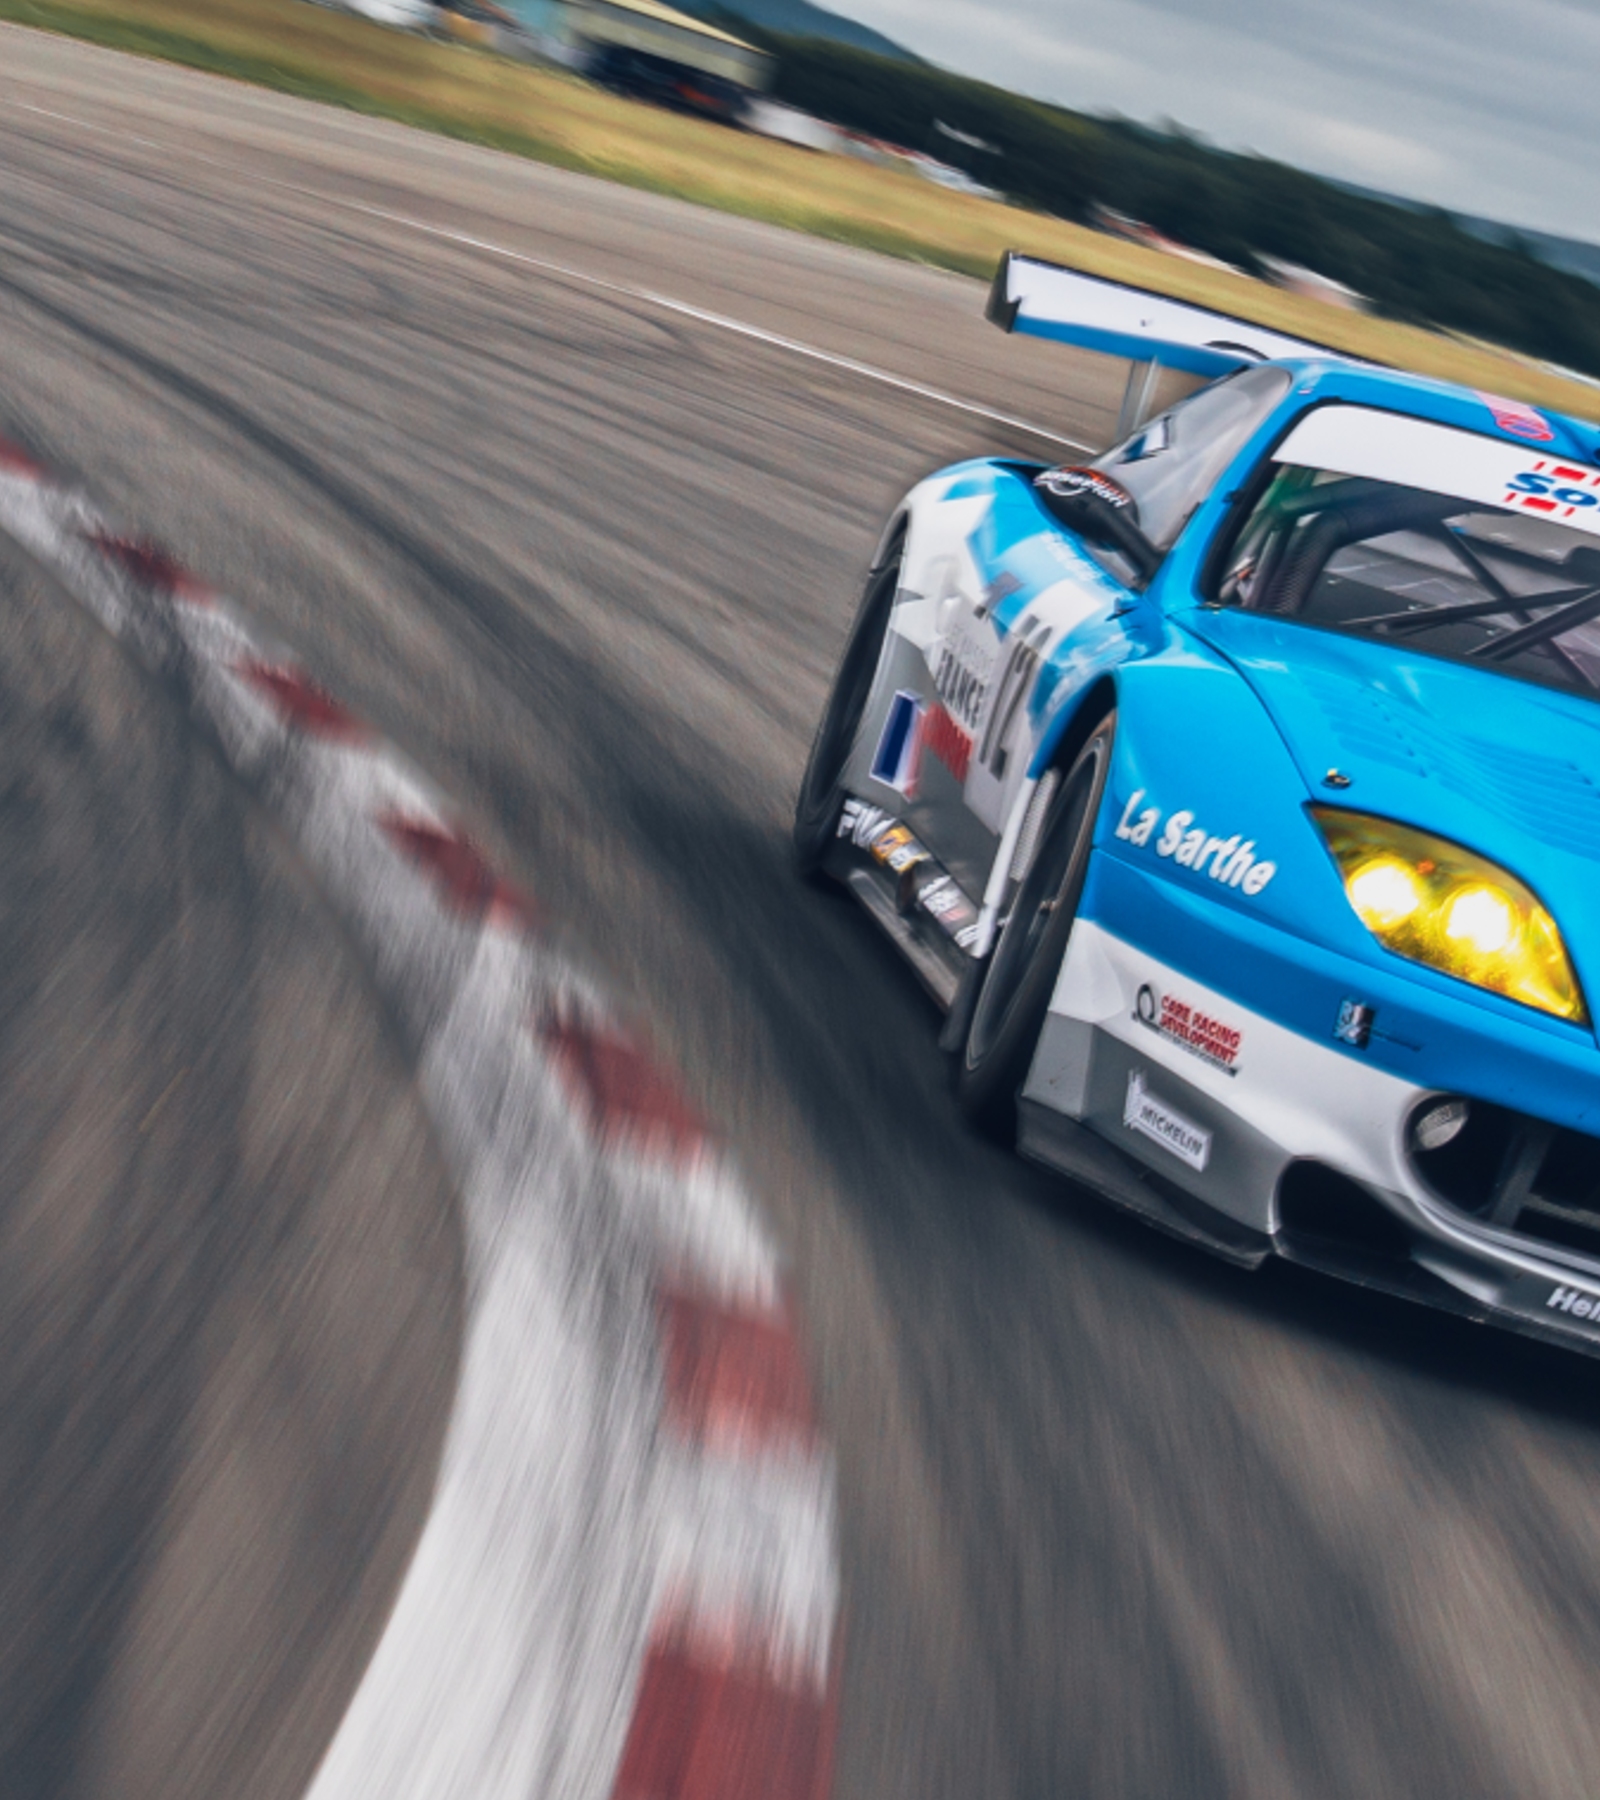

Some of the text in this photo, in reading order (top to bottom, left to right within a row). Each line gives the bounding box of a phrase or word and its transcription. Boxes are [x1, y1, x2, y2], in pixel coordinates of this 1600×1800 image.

[1114, 787, 1278, 897] La Sarthe
[1158, 1011, 1239, 1066] DEVELOPMENT
[1161, 993, 1243, 1049] CARE RACING
[1140, 1104, 1203, 1157] MICHELIN
